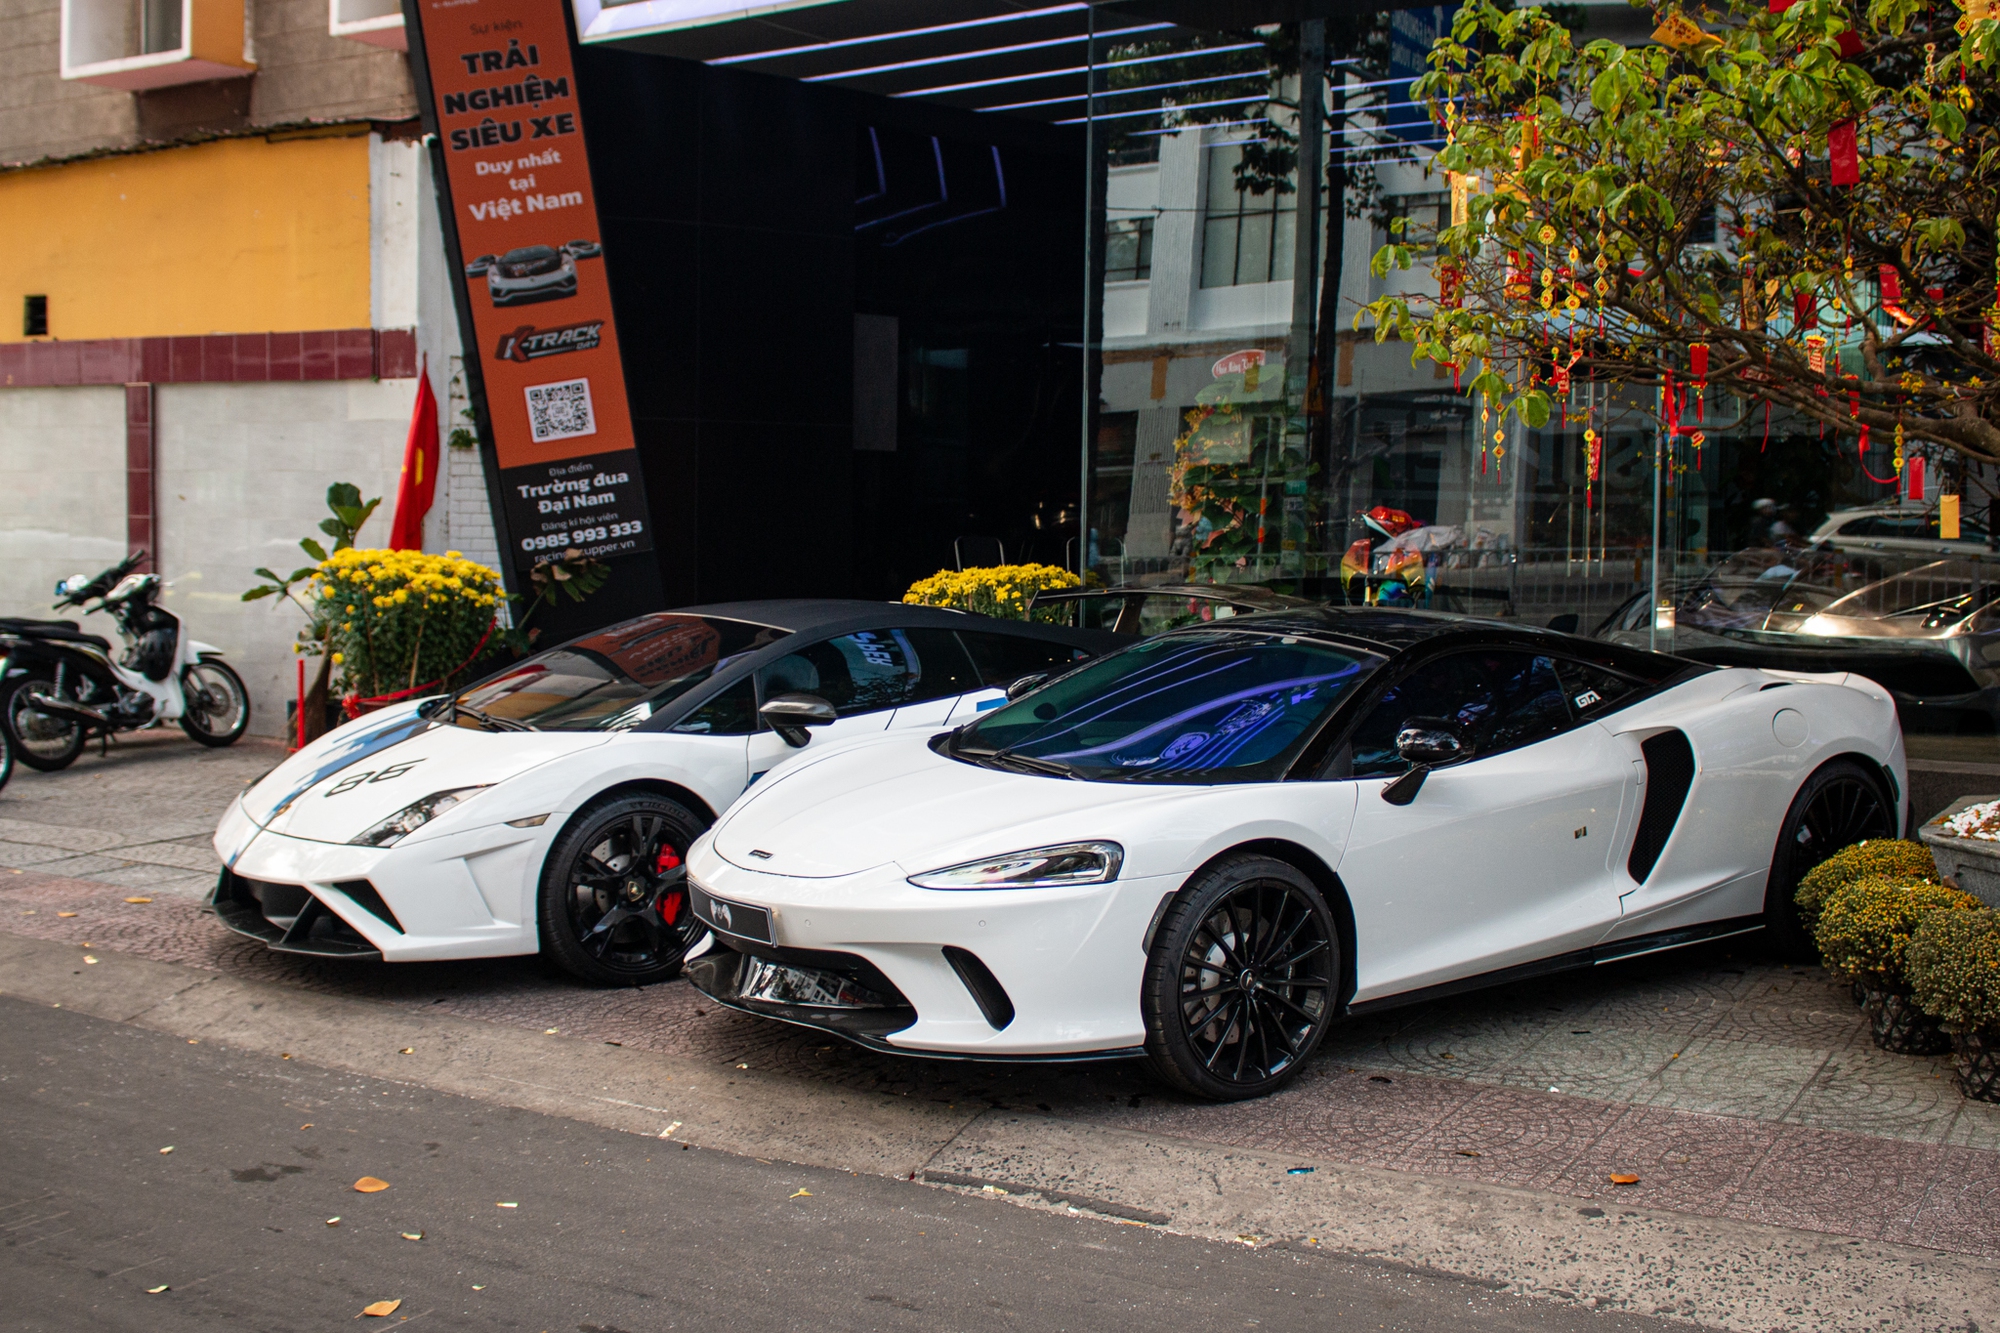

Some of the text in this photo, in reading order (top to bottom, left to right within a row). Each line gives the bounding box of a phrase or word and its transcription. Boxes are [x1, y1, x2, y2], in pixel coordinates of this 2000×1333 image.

[460, 38, 539, 75] TRẢI
[443, 74, 570, 115] NGHIỆM
[449, 112, 576, 151] SIÊU XE
[475, 148, 562, 176] Duy nhất
[509, 174, 537, 191] tại
[468, 190, 583, 221] Việt Nam
[503, 322, 603, 361] K-TRACK
[516, 471, 630, 499] Trường đua
[537, 491, 616, 515] Đại Nam
[520, 519, 643, 552] 0985 993 333
